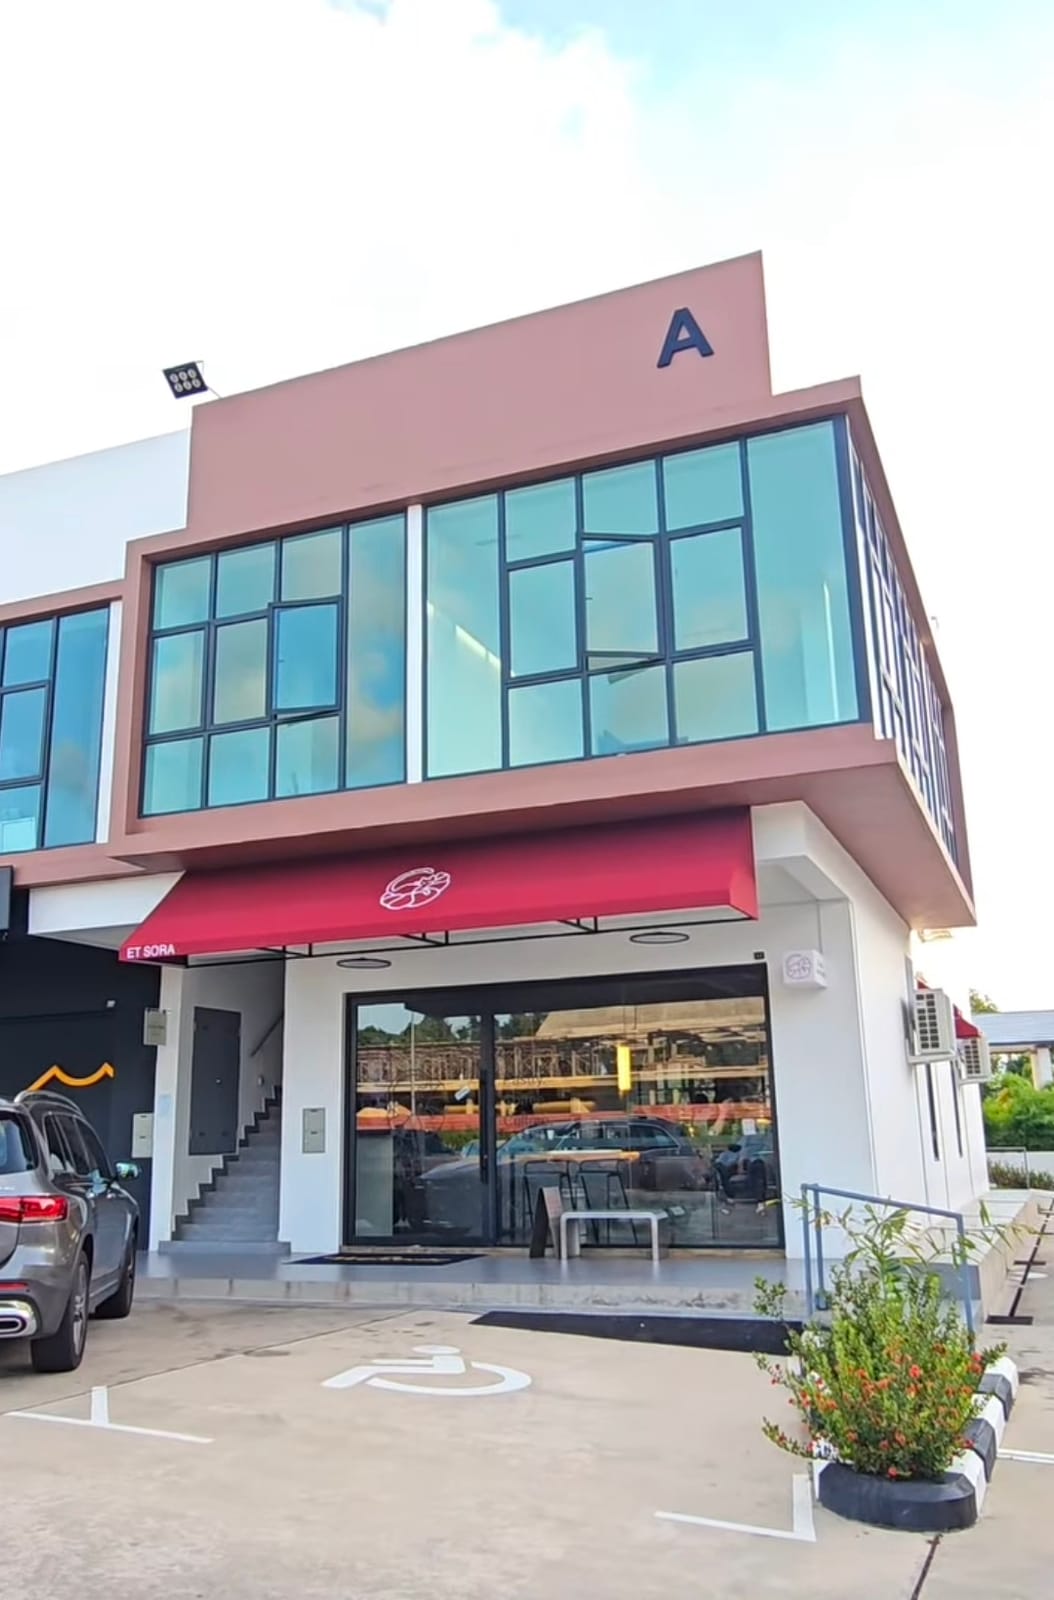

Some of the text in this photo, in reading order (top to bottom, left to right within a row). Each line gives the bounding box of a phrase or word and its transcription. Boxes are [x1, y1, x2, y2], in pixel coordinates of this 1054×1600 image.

[657, 307, 714, 368] A
[127, 944, 174, 959] ET SORA
